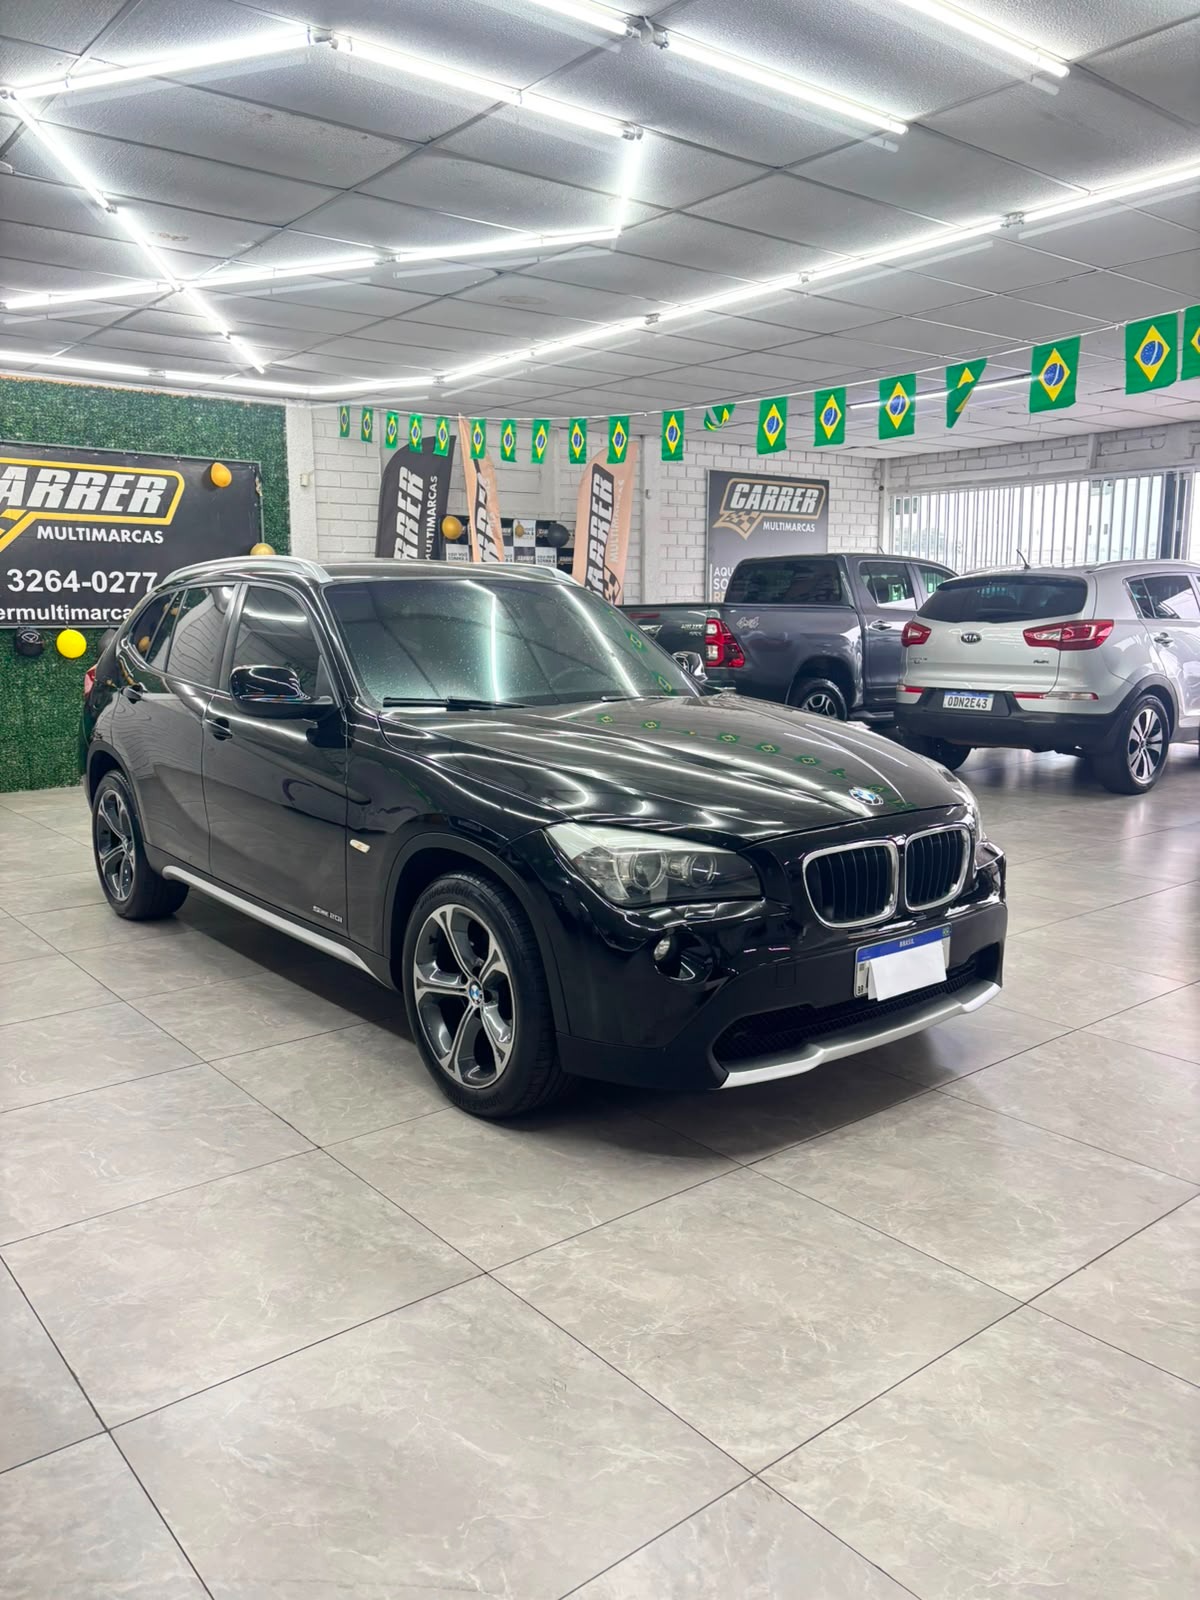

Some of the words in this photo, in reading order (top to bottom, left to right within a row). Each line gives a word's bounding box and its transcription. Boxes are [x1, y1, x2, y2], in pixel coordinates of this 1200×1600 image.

[730, 483, 819, 513] CARRER
[36, 525, 164, 544] MULTIMARCAS
[762, 521, 815, 533] MULTIMARCAS
[7, 568, 158, 593] 3264-0277
[963, 634, 979, 642] KIA
